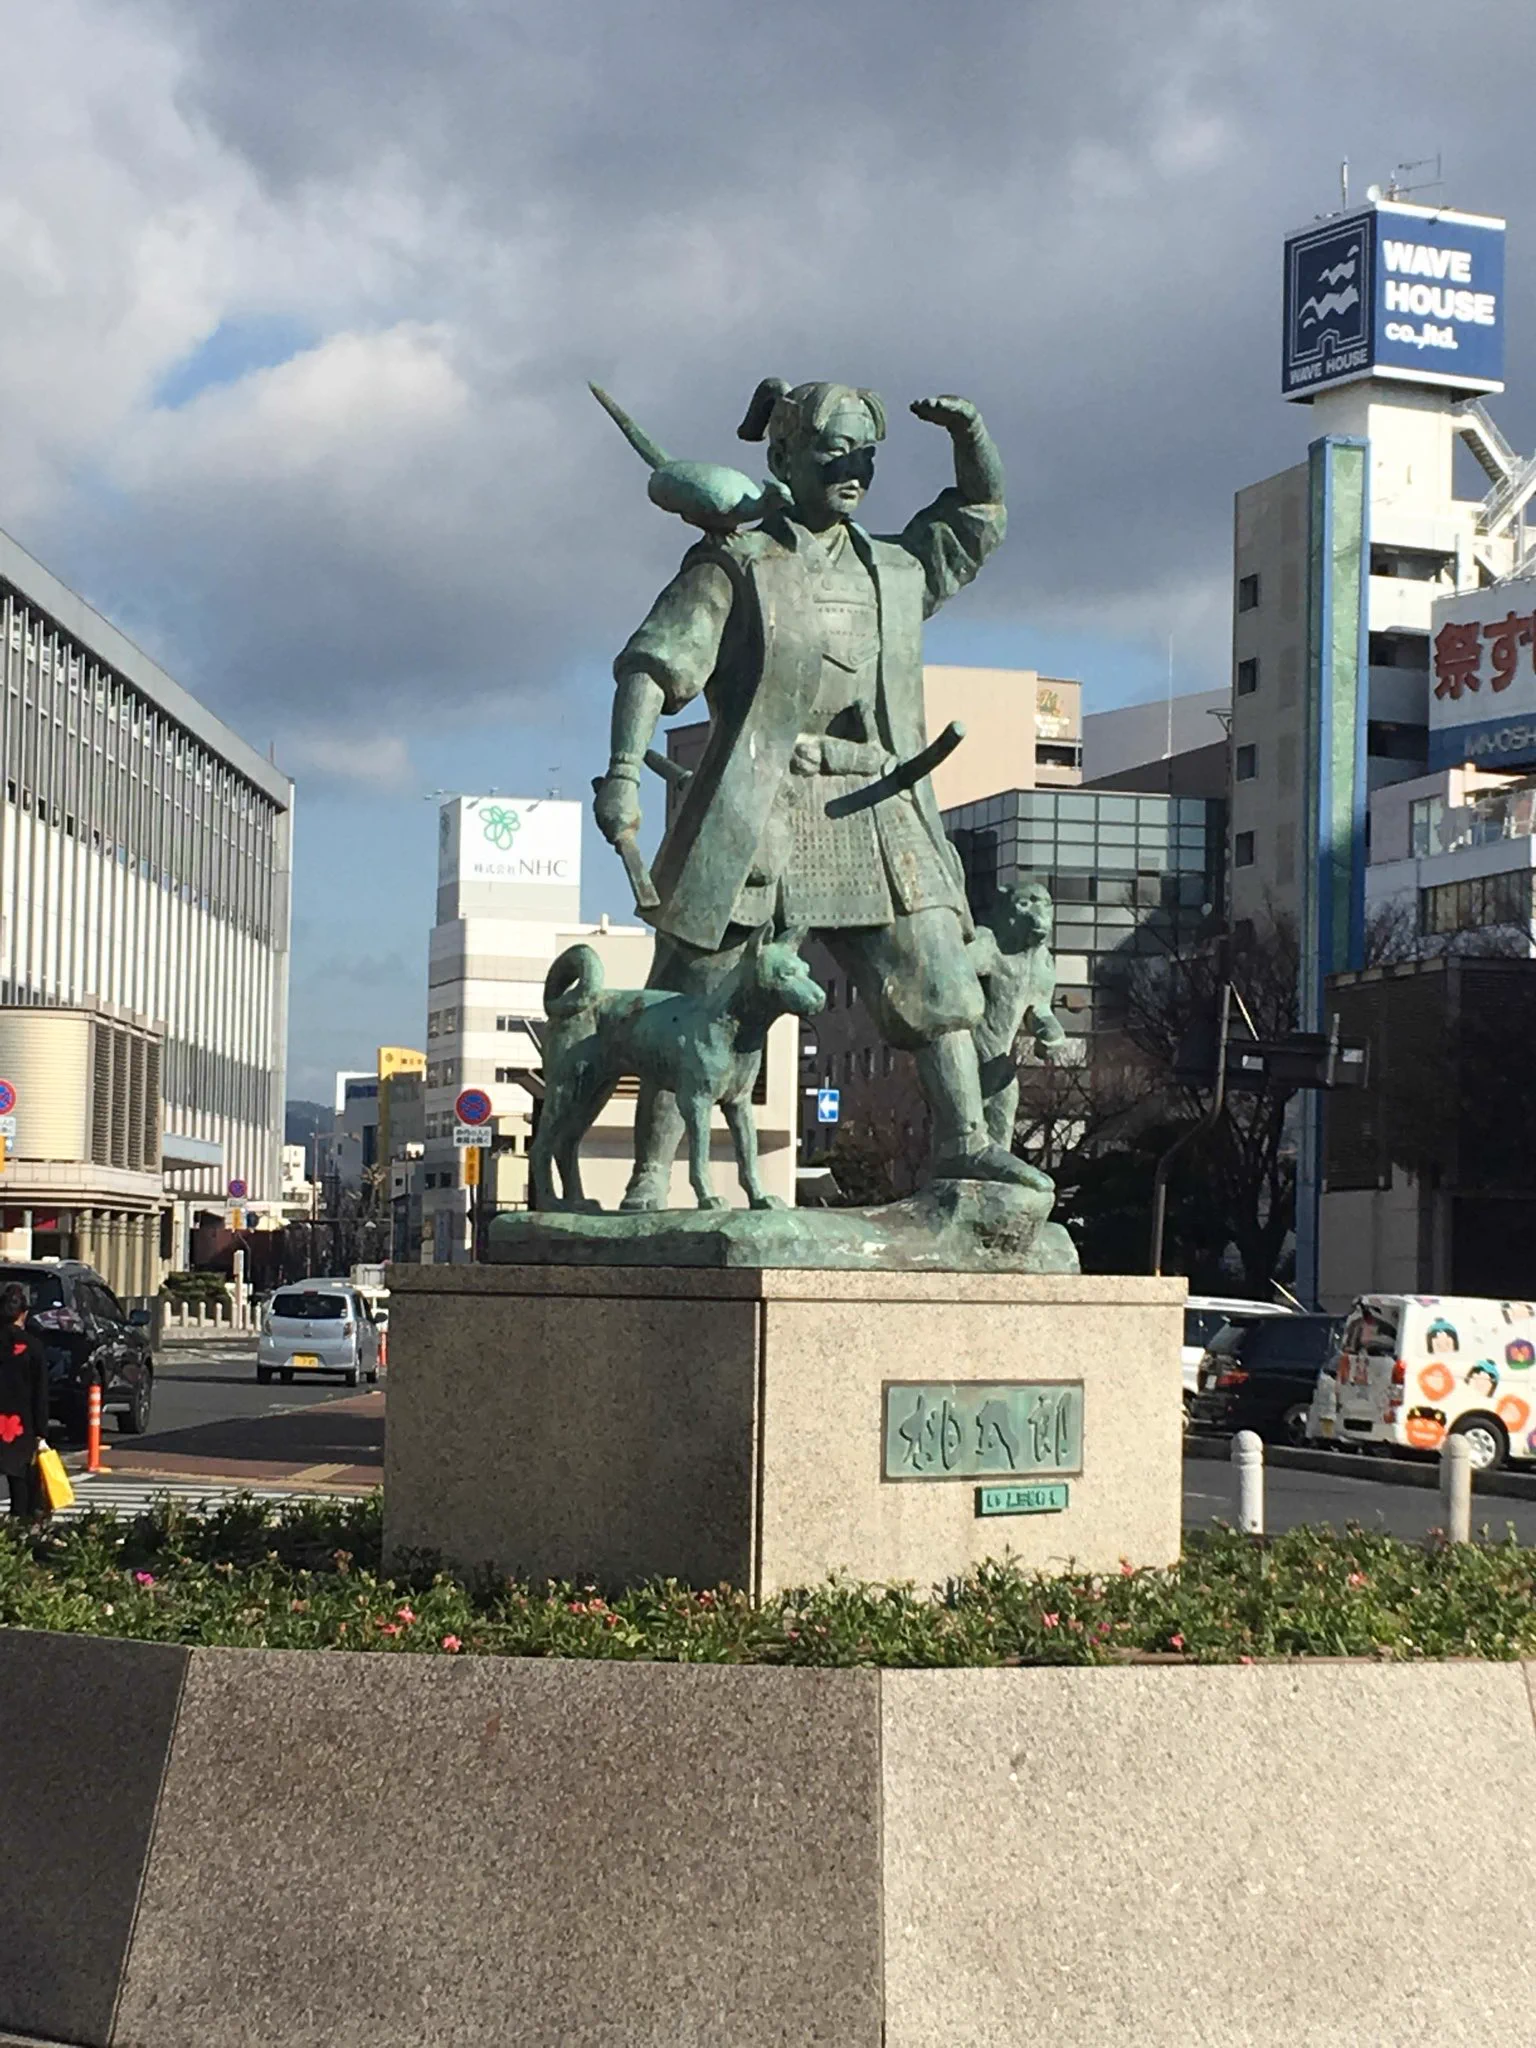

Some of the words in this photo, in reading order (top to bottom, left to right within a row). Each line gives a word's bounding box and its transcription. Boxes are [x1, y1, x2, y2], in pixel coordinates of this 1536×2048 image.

[1382, 240, 1472, 282] WAVE
[1384, 280, 1496, 325] HOUSE
[1289, 362, 1323, 385] WAVE
[1325, 347, 1369, 373] HOUSE
